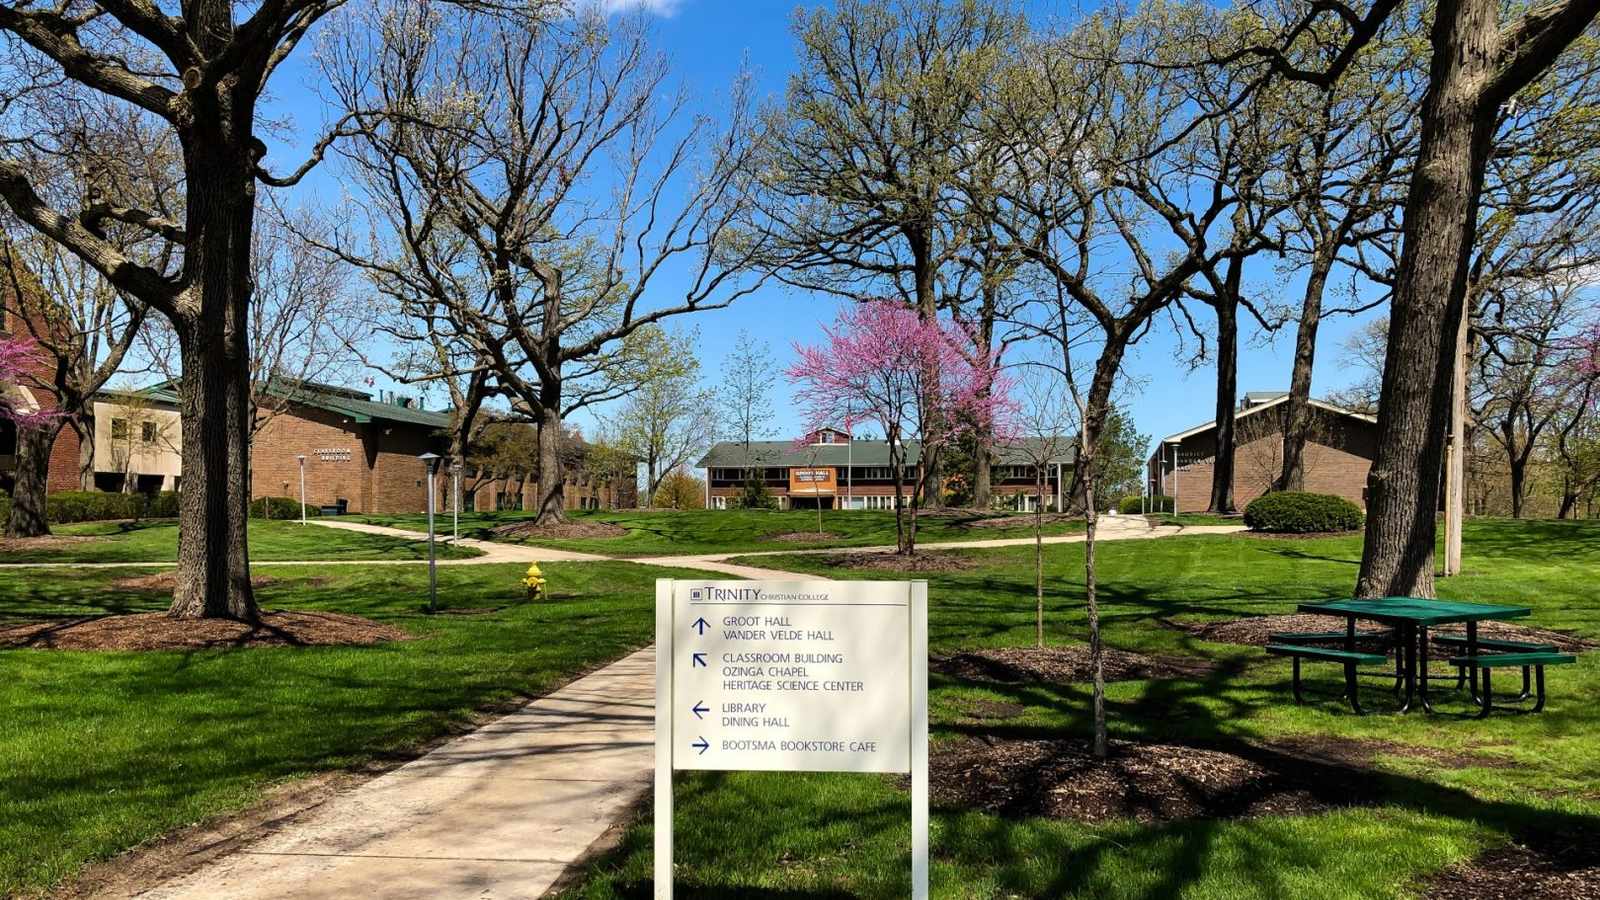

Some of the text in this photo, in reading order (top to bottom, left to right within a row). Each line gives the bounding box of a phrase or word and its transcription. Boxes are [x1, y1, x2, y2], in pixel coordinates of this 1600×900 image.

[704, 586, 761, 601] TRINITY
[799, 593, 829, 601] COLLEGE
[723, 616, 792, 627] GROOT HALL
[723, 630, 834, 641] VANDER VELDE HALL
[722, 653, 843, 664] CLASSROOM BUILDING
[722, 666, 808, 678] OZINGA CHAPEL
[722, 680, 864, 692] HERITAGE SCIENCE CENTER
[722, 703, 766, 714] LIBRARY
[722, 717, 790, 728] DINING HALL
[722, 740, 876, 753] BOOTSMA BOOKSTORE CAFE
